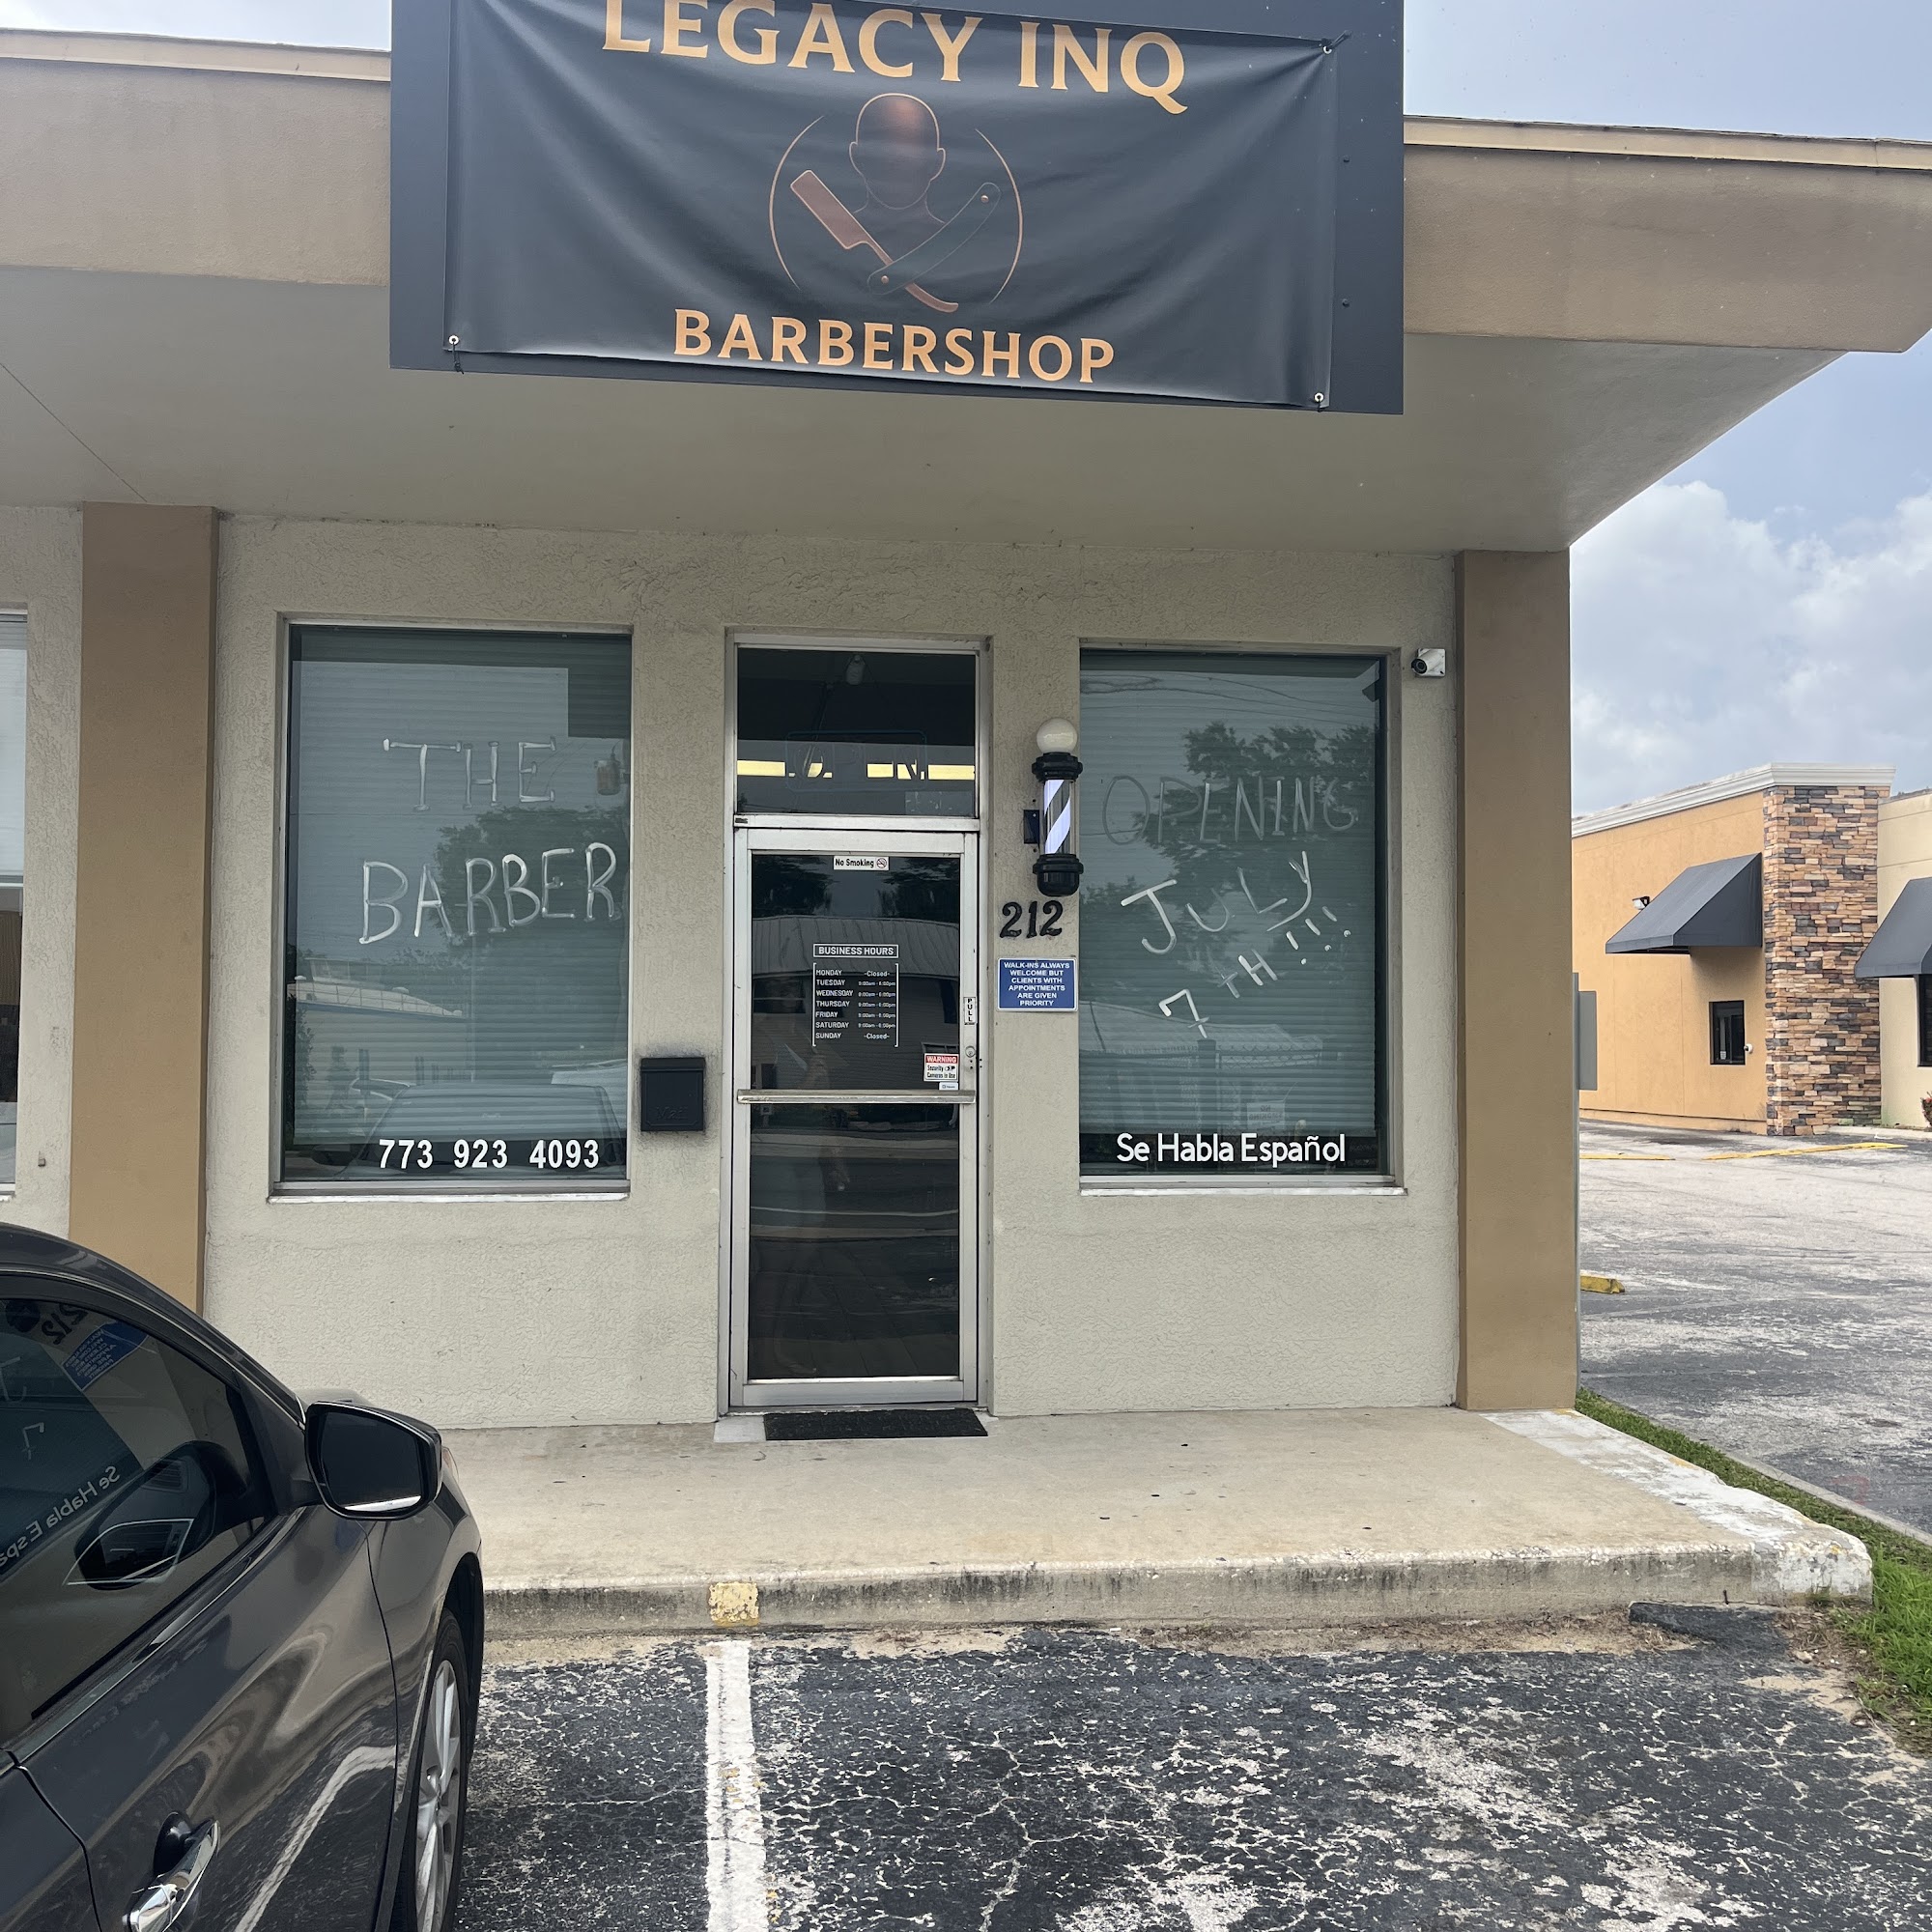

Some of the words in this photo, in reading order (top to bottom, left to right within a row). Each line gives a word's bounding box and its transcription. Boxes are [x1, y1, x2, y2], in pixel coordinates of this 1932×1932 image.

[603, 0, 983, 82] LEGACY
[1017, 20, 1188, 115] INQ
[673, 308, 1115, 384] BARBERSHOP
[383, 735, 556, 811] THE
[1102, 775, 1359, 845] OPENING
[835, 858, 844, 867] No
[845, 858, 874, 868] Smoking
[358, 841, 618, 945] BARBER
[999, 899, 1064, 938] 212
[1121, 850, 1313, 955] JULY
[818, 946, 863, 955] BUSINESS
[864, 947, 895, 955] HOURS
[926, 1055, 957, 1064] WARNING
[379, 1138, 434, 1169] 773
[453, 1138, 508, 1169] 923
[529, 1138, 599, 1169] 4093
[1116, 1132, 1151, 1162] Se
[1157, 1132, 1235, 1162] Habla
[1240, 1133, 1346, 1168] Español
